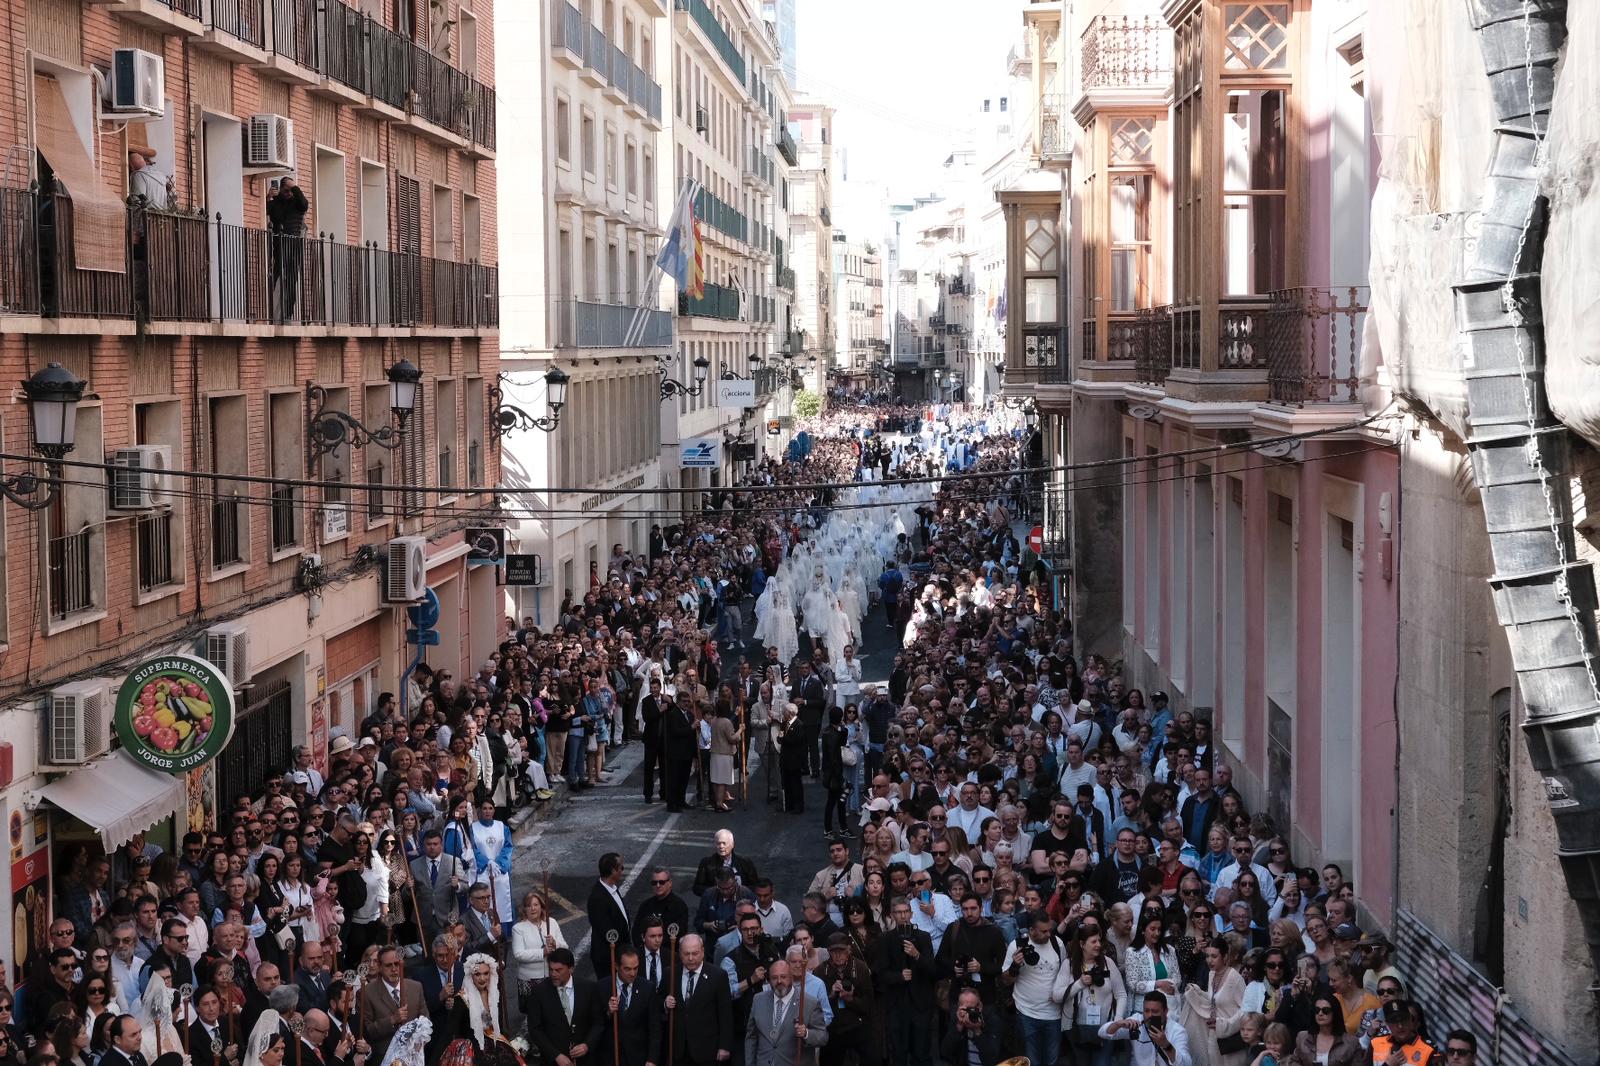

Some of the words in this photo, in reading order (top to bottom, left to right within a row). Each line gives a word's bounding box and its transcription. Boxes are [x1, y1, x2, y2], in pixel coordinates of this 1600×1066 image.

[134, 661, 210, 684] SUPERMERCA
[137, 747, 173, 768] JORGE
[180, 748, 207, 768] JUAN
